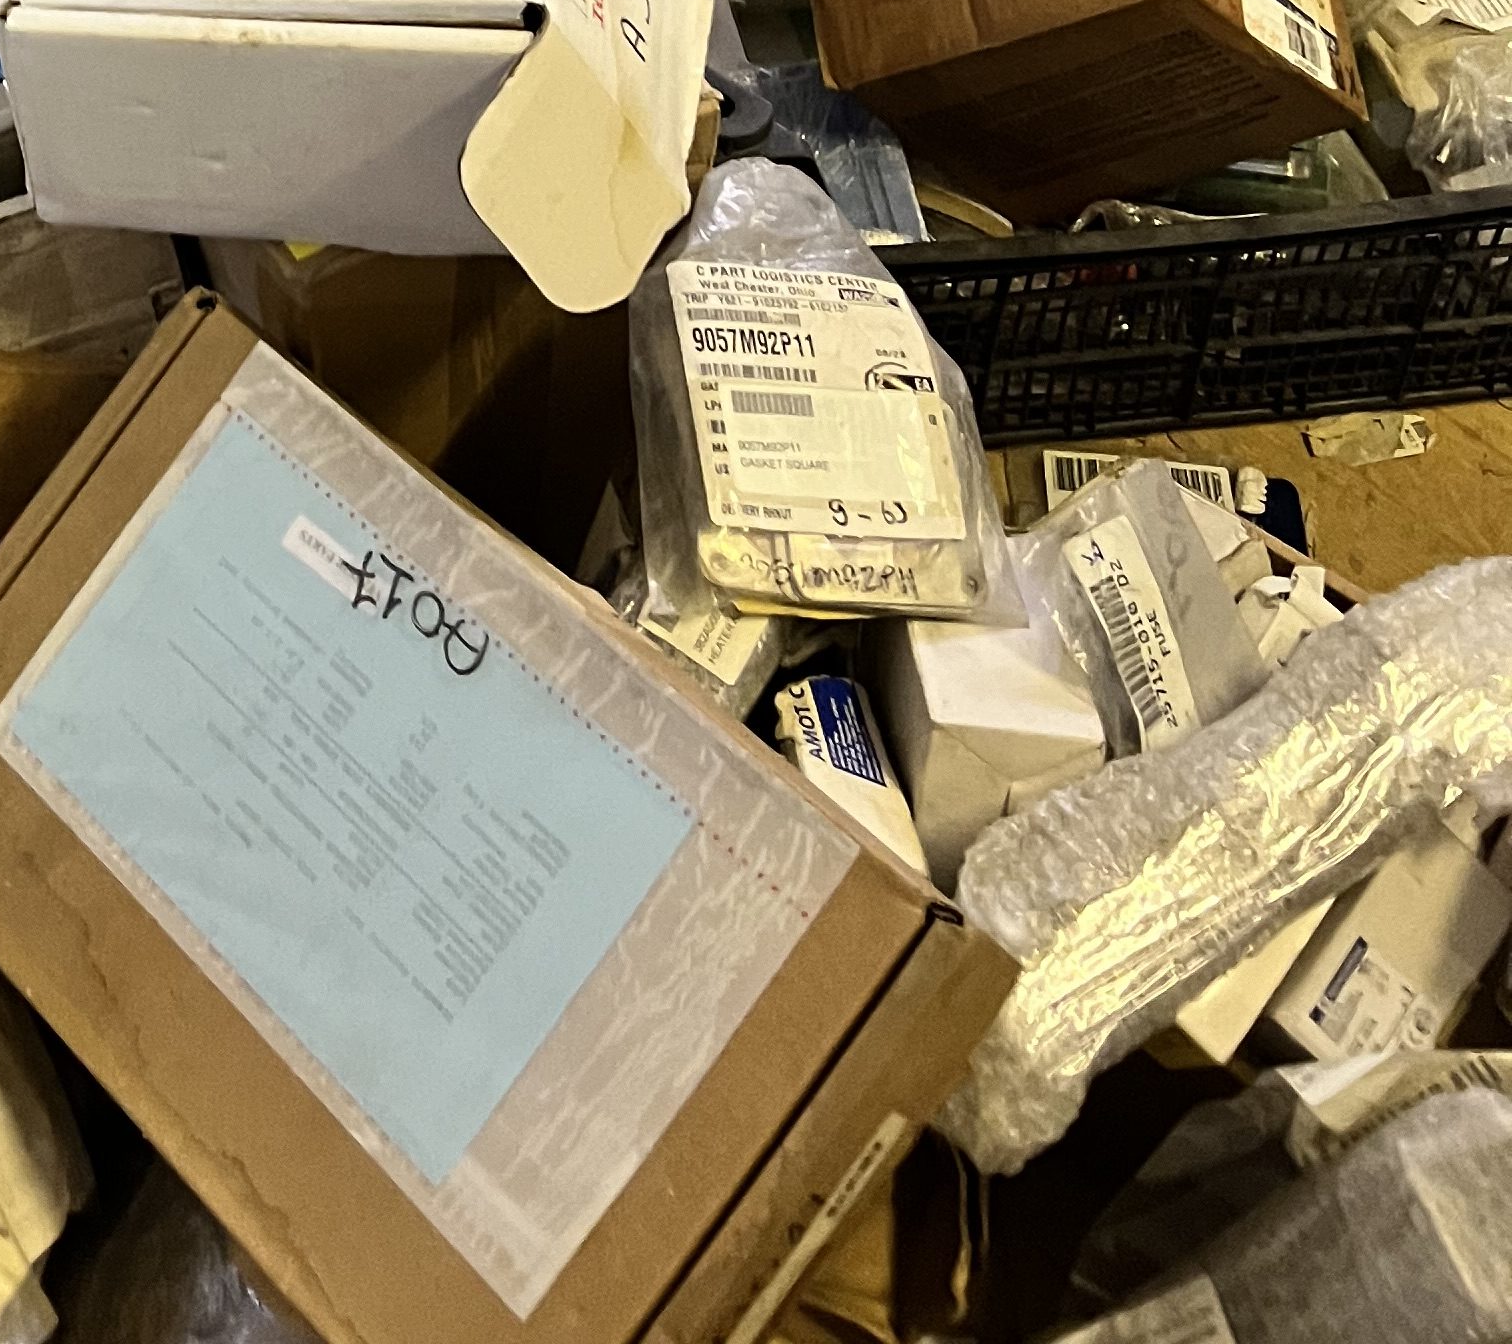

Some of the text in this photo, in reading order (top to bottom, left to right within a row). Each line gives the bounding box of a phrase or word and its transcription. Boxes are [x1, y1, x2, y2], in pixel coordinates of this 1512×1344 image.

[697, 277, 732, 291] West
[709, 264, 747, 279] PART
[751, 267, 824, 286] LOGISTICS
[691, 326, 817, 359] 9057M92P11
[739, 456, 830, 472] GASKET SQUARE
[1145, 608, 1172, 660] FUSE
[792, 705, 827, 764] AMOT
